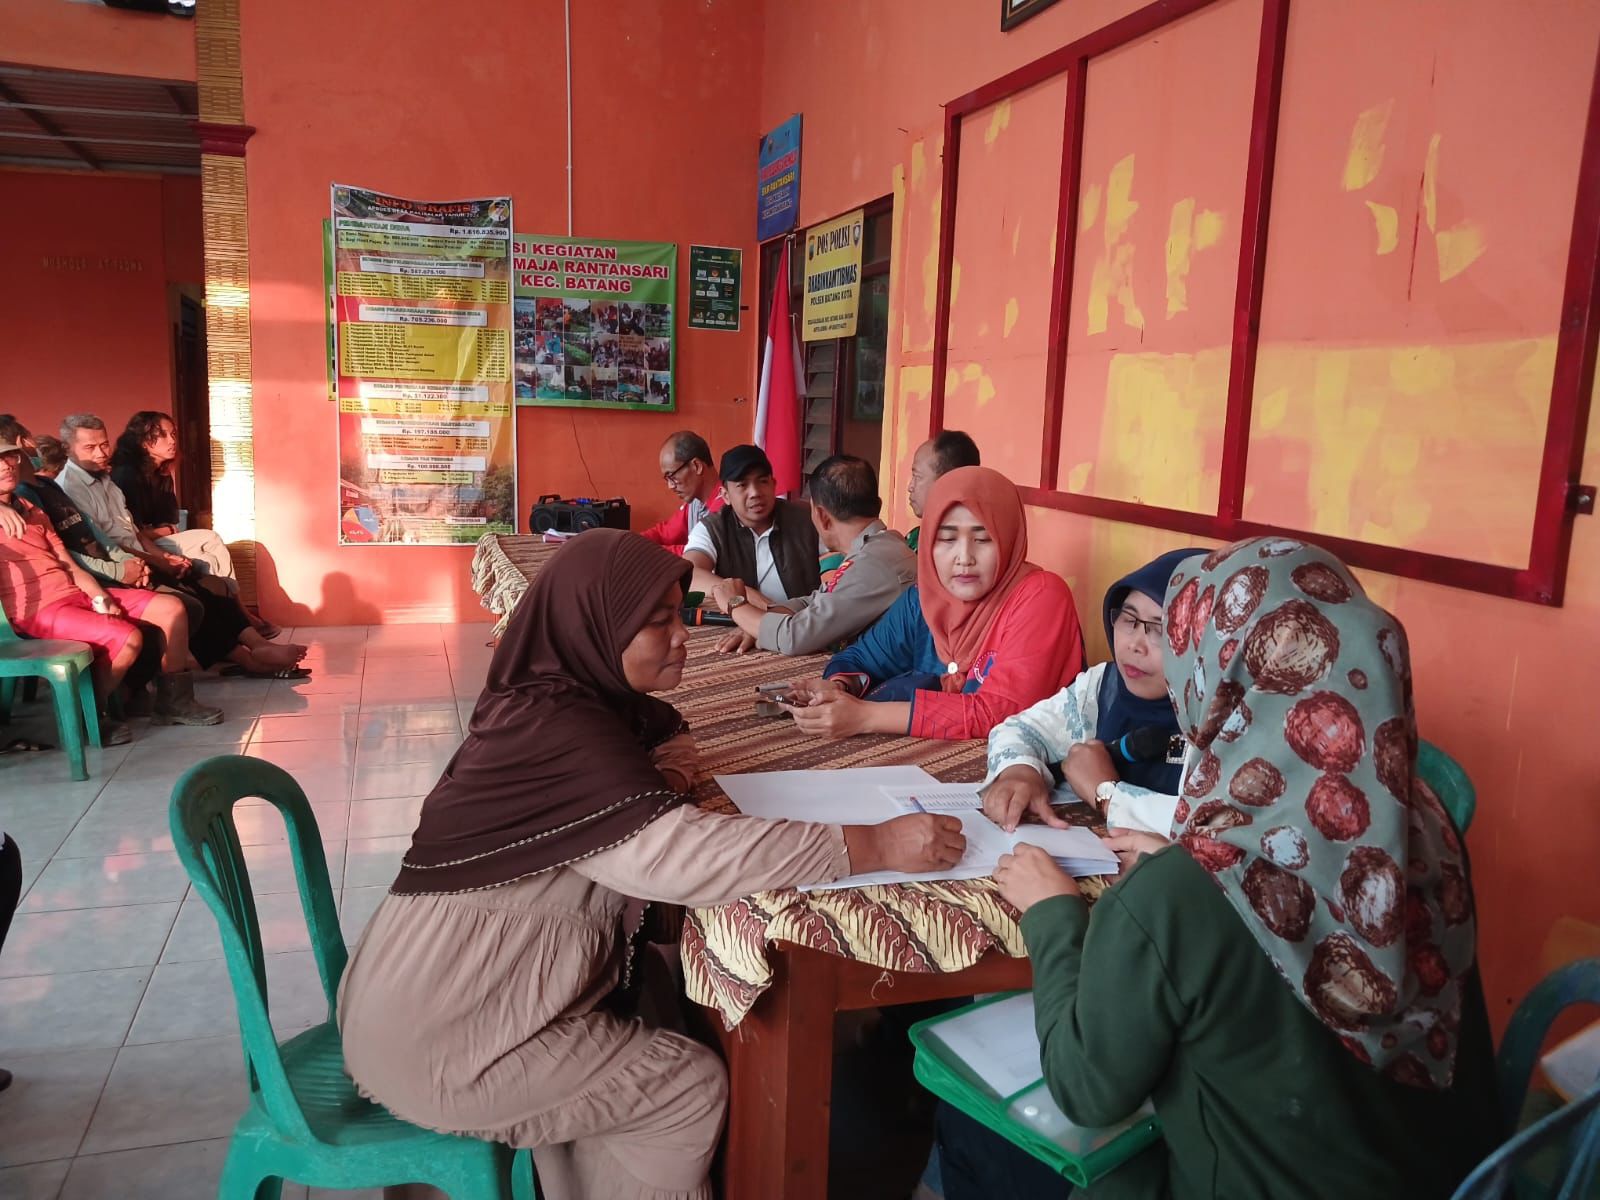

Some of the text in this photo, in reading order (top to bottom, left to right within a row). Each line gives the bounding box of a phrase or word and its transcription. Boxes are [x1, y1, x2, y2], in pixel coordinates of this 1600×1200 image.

[816, 225, 851, 256] POS POLISI
[532, 243, 616, 260] KEGIATAN
[513, 257, 669, 279] MAJA RANTANSARI
[521, 274, 631, 293] KEC. BATANG
